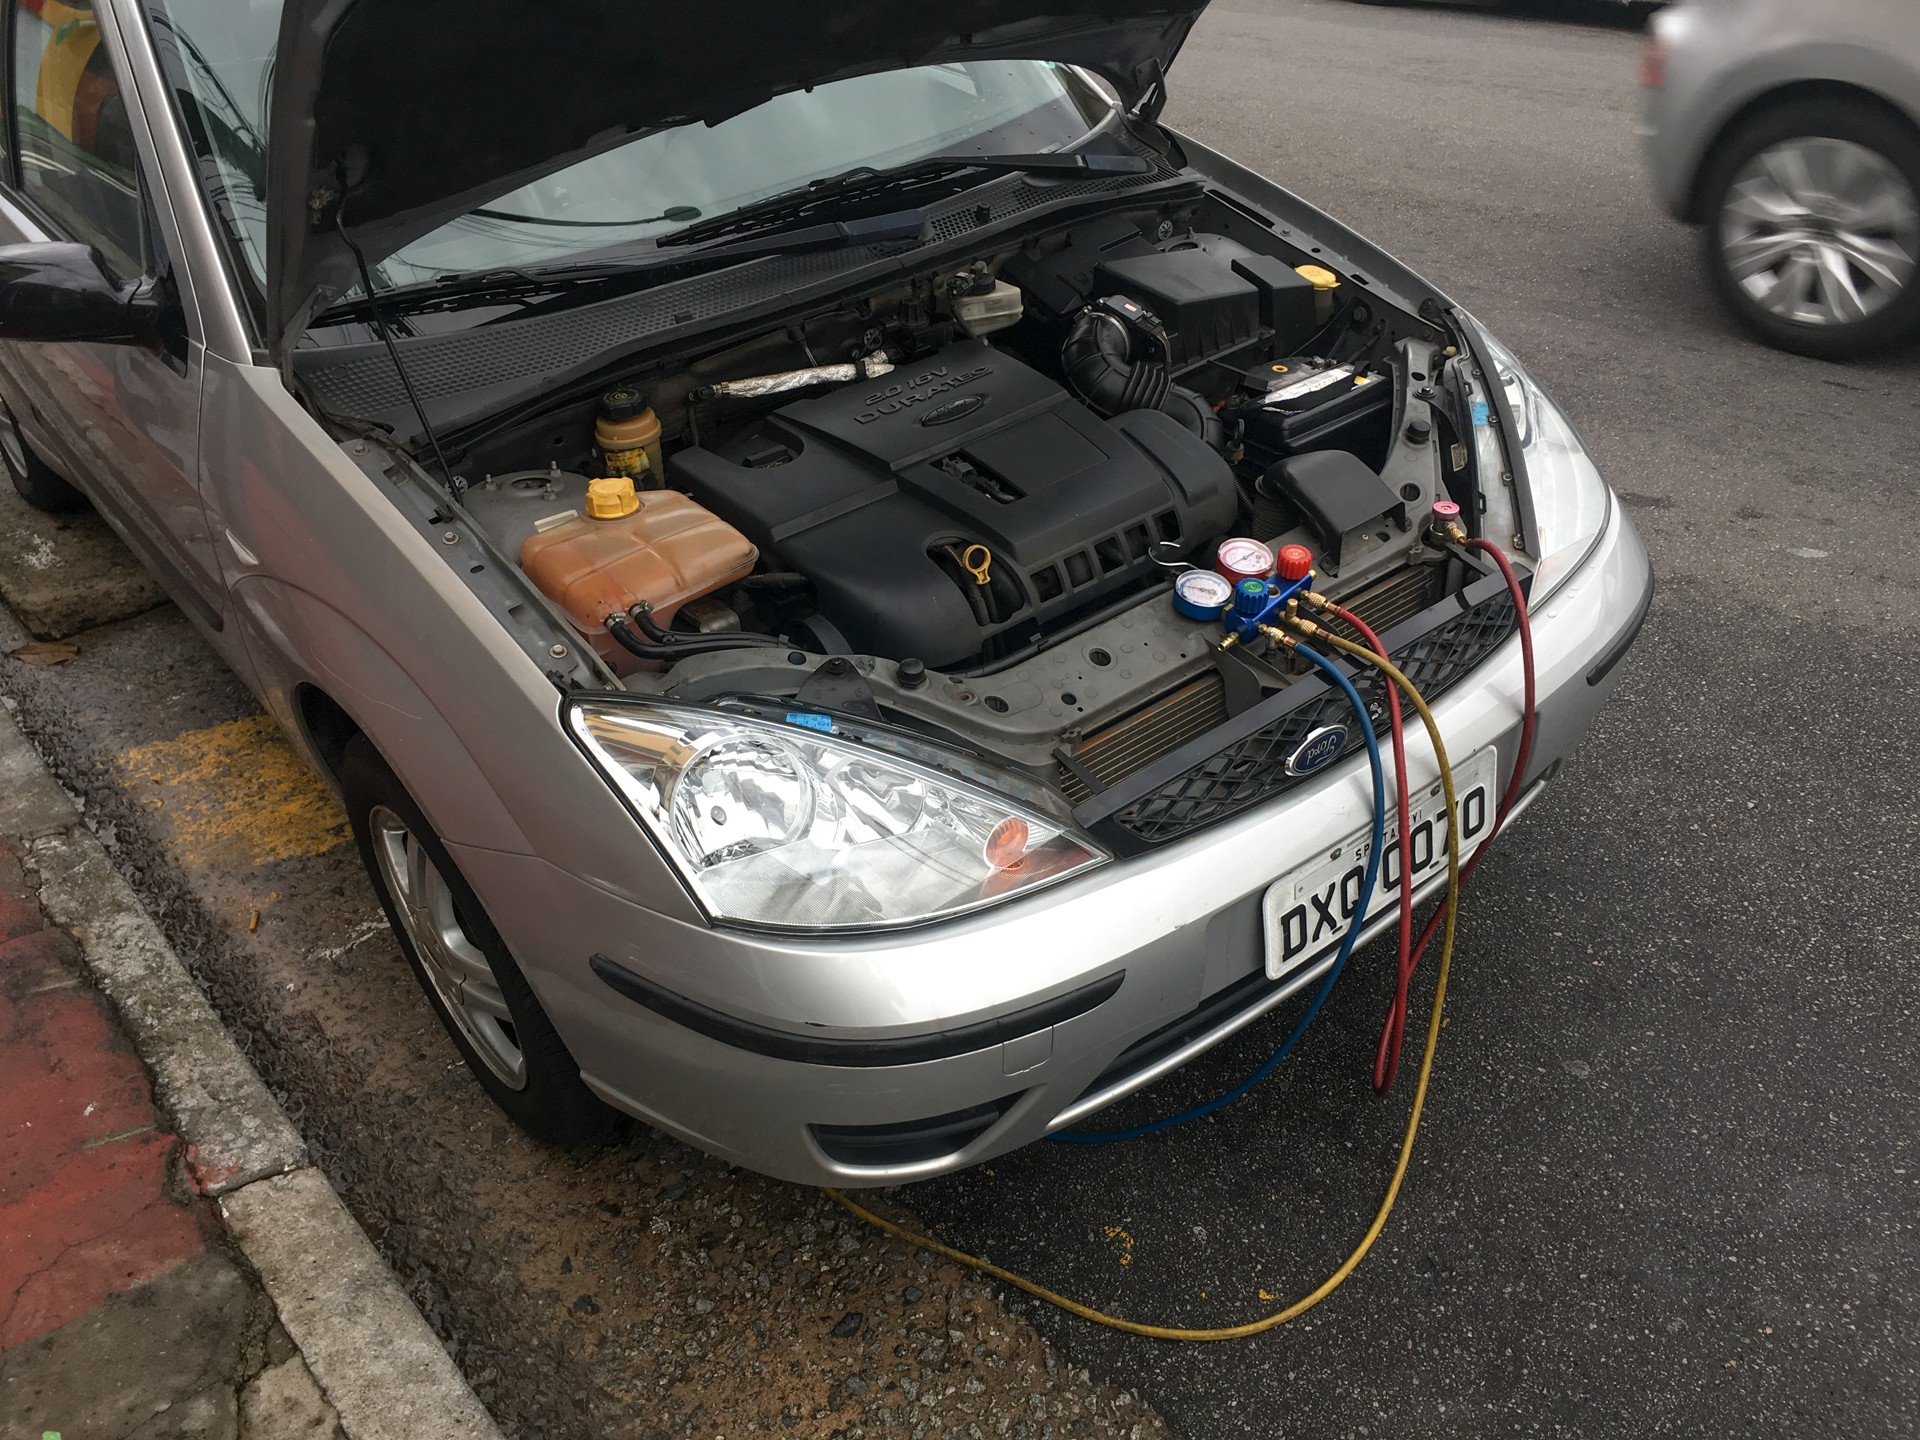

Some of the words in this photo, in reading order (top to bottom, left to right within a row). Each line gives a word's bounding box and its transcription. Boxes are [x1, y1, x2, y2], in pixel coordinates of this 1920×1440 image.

[854, 366, 993, 424] DURATEC
[865, 384, 903, 406] 2.0
[907, 366, 948, 389] 16V
[1305, 734, 1337, 766] Ford
[1280, 865, 1366, 962] DXQ
[1382, 786, 1485, 892] 0070
